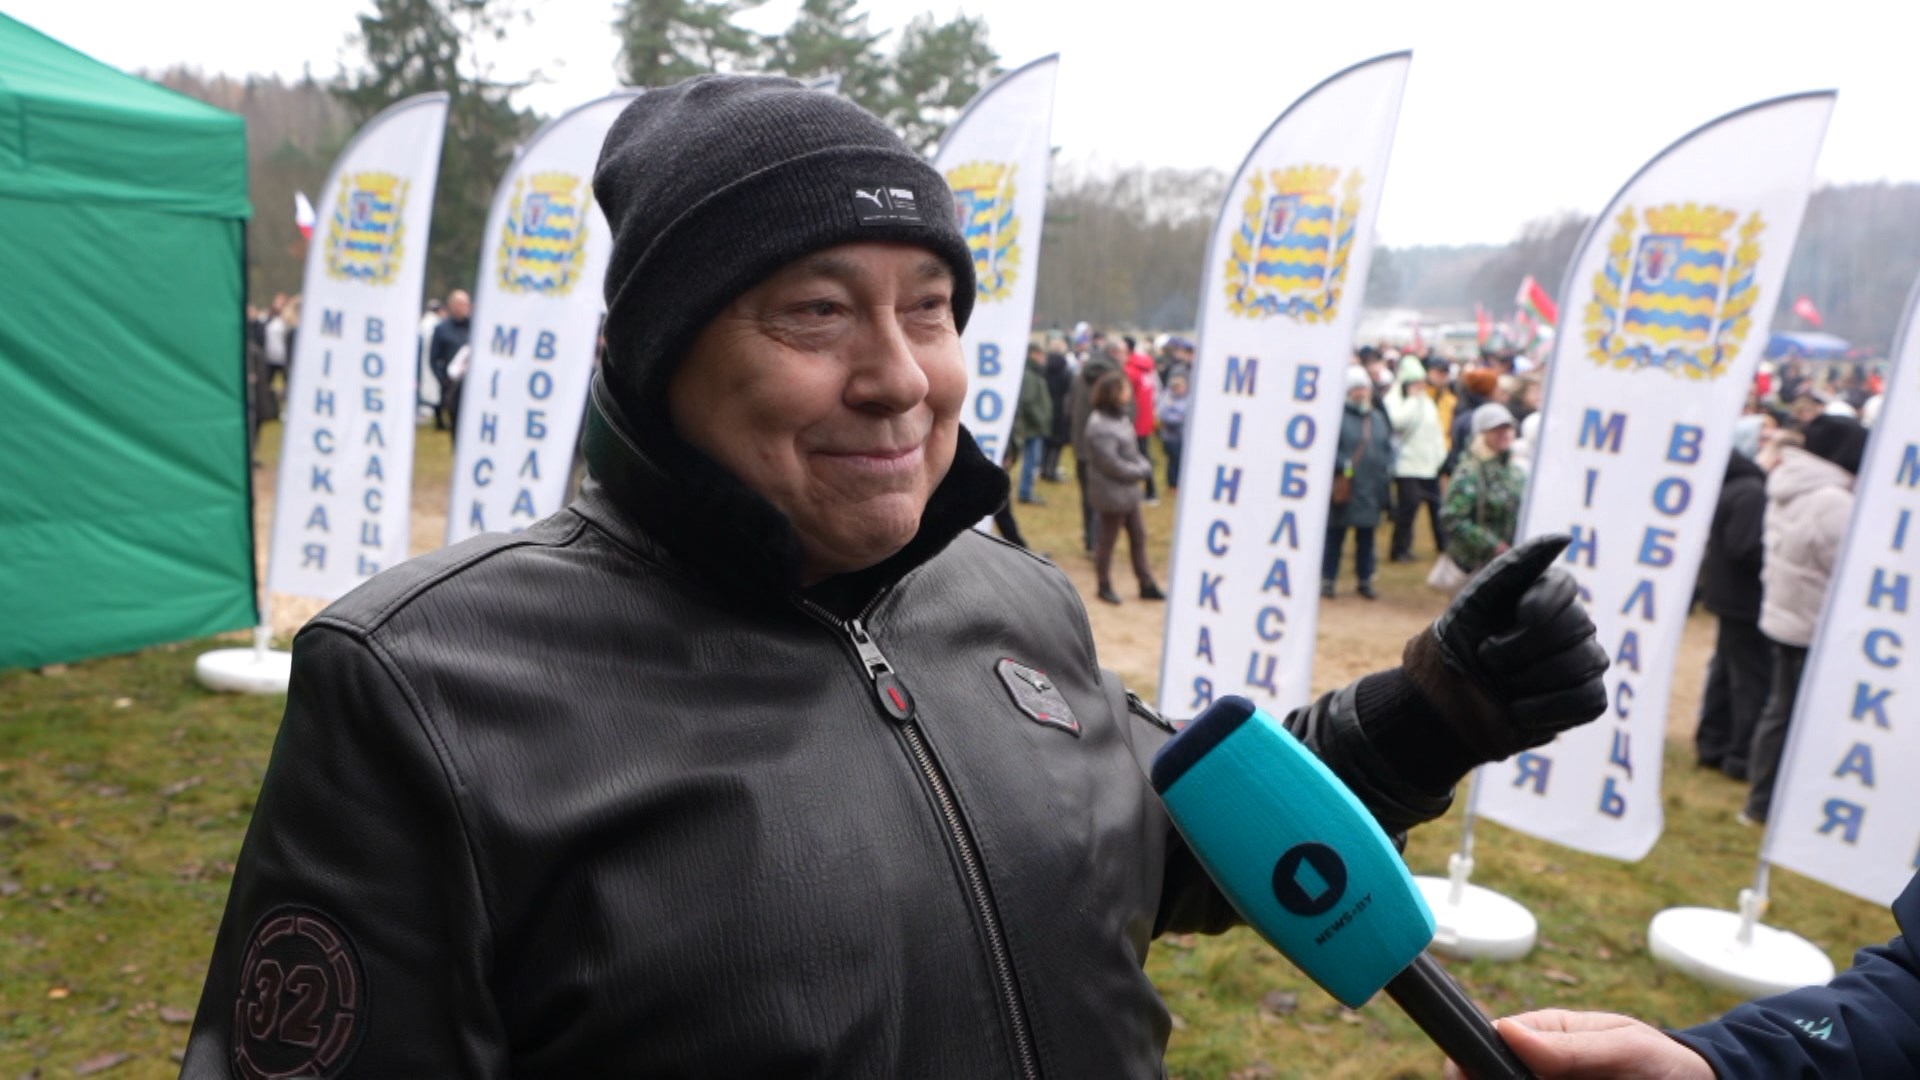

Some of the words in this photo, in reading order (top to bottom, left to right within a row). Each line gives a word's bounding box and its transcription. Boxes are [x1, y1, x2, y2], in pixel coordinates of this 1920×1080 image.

[301, 308, 343, 571] МІНСКАЯ
[469, 325, 518, 532] МІНСК
[510, 330, 557, 534] ВОБЛА
[1190, 356, 1259, 710] МІНСКАЯ
[1246, 364, 1320, 697] ВОБЛАСЦ
[1512, 408, 1627, 796] МІНЯ
[1599, 423, 1705, 819] ВОБЛАСЦЬ
[247, 959, 328, 1048] 32
